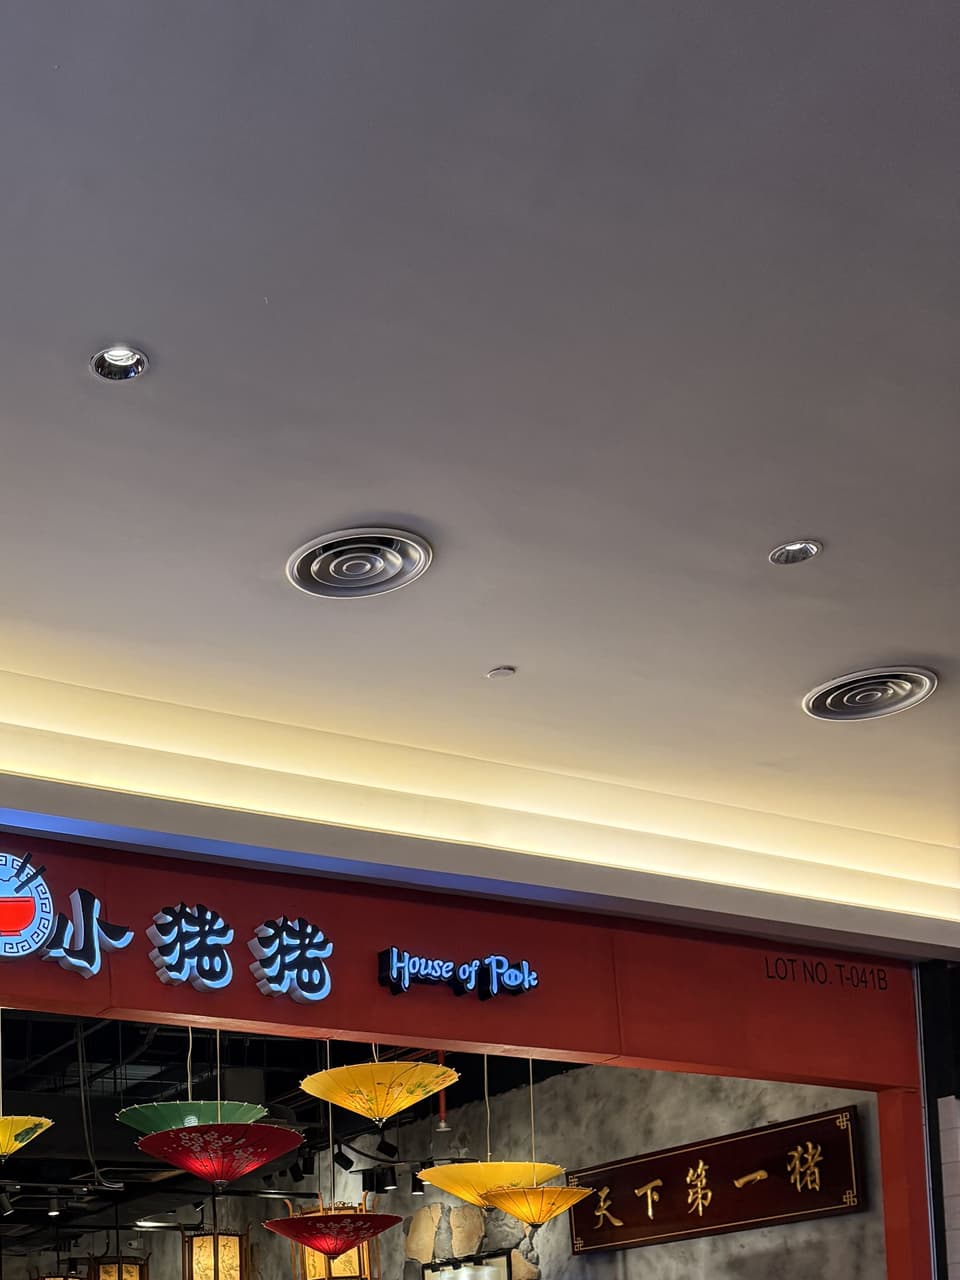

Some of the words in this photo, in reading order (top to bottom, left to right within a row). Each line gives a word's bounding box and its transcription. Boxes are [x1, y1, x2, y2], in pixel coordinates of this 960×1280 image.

[42, 887, 334, 1003] 小猪猪
[390, 946, 454, 991] House
[458, 959, 480, 990] of
[765, 957, 797, 980] LOT
[803, 960, 833, 985] NO.
[835, 963, 889, 991] T-041B
